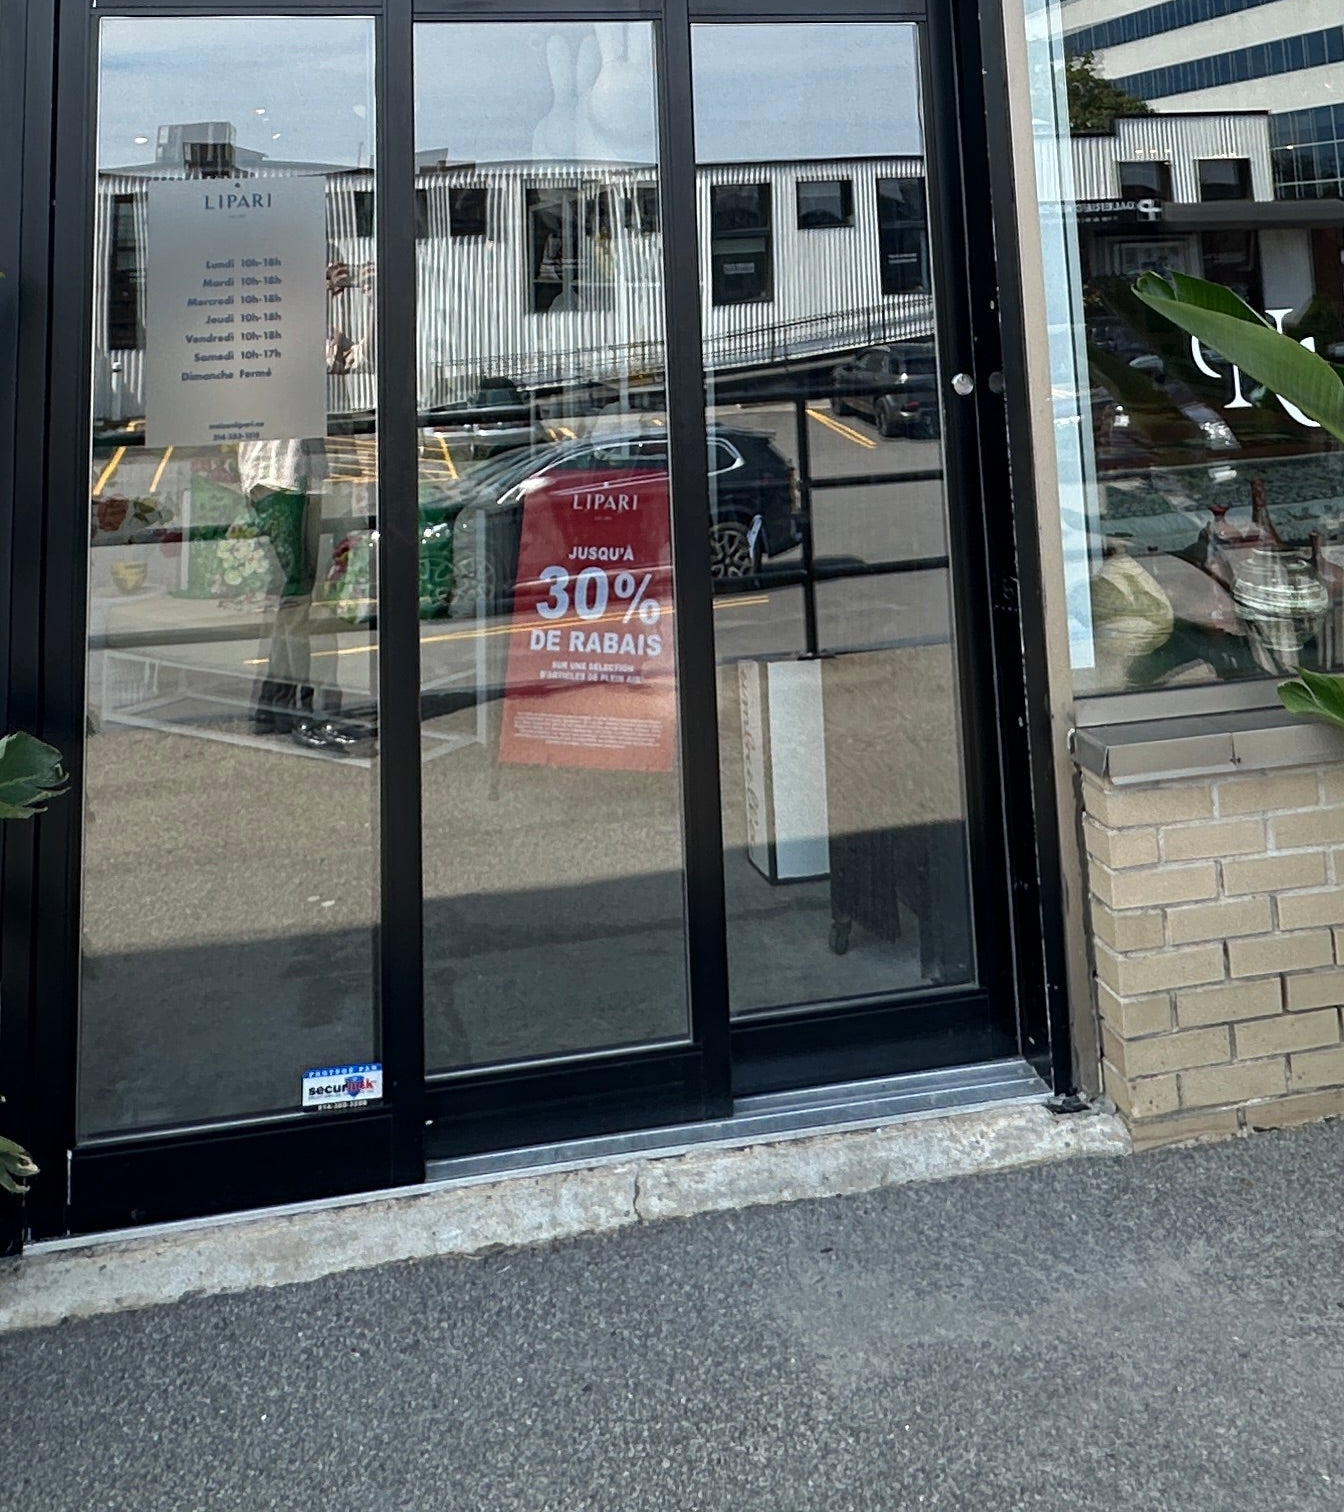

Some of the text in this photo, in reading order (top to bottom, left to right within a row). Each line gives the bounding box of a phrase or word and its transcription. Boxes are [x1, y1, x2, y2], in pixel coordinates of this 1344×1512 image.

[204, 192, 273, 211] LIPARI
[206, 259, 234, 269] Lundi
[202, 277, 234, 288] Mardi
[205, 313, 234, 324] Jeudi
[185, 332, 234, 344] Vendredi
[194, 350, 234, 362] Samedi
[181, 370, 233, 381] Dimanche
[572, 492, 639, 513] LIPARI
[568, 545, 635, 562] JUSQU'À
[536, 565, 661, 626] 30%
[529, 629, 662, 657] DE RABAIS
